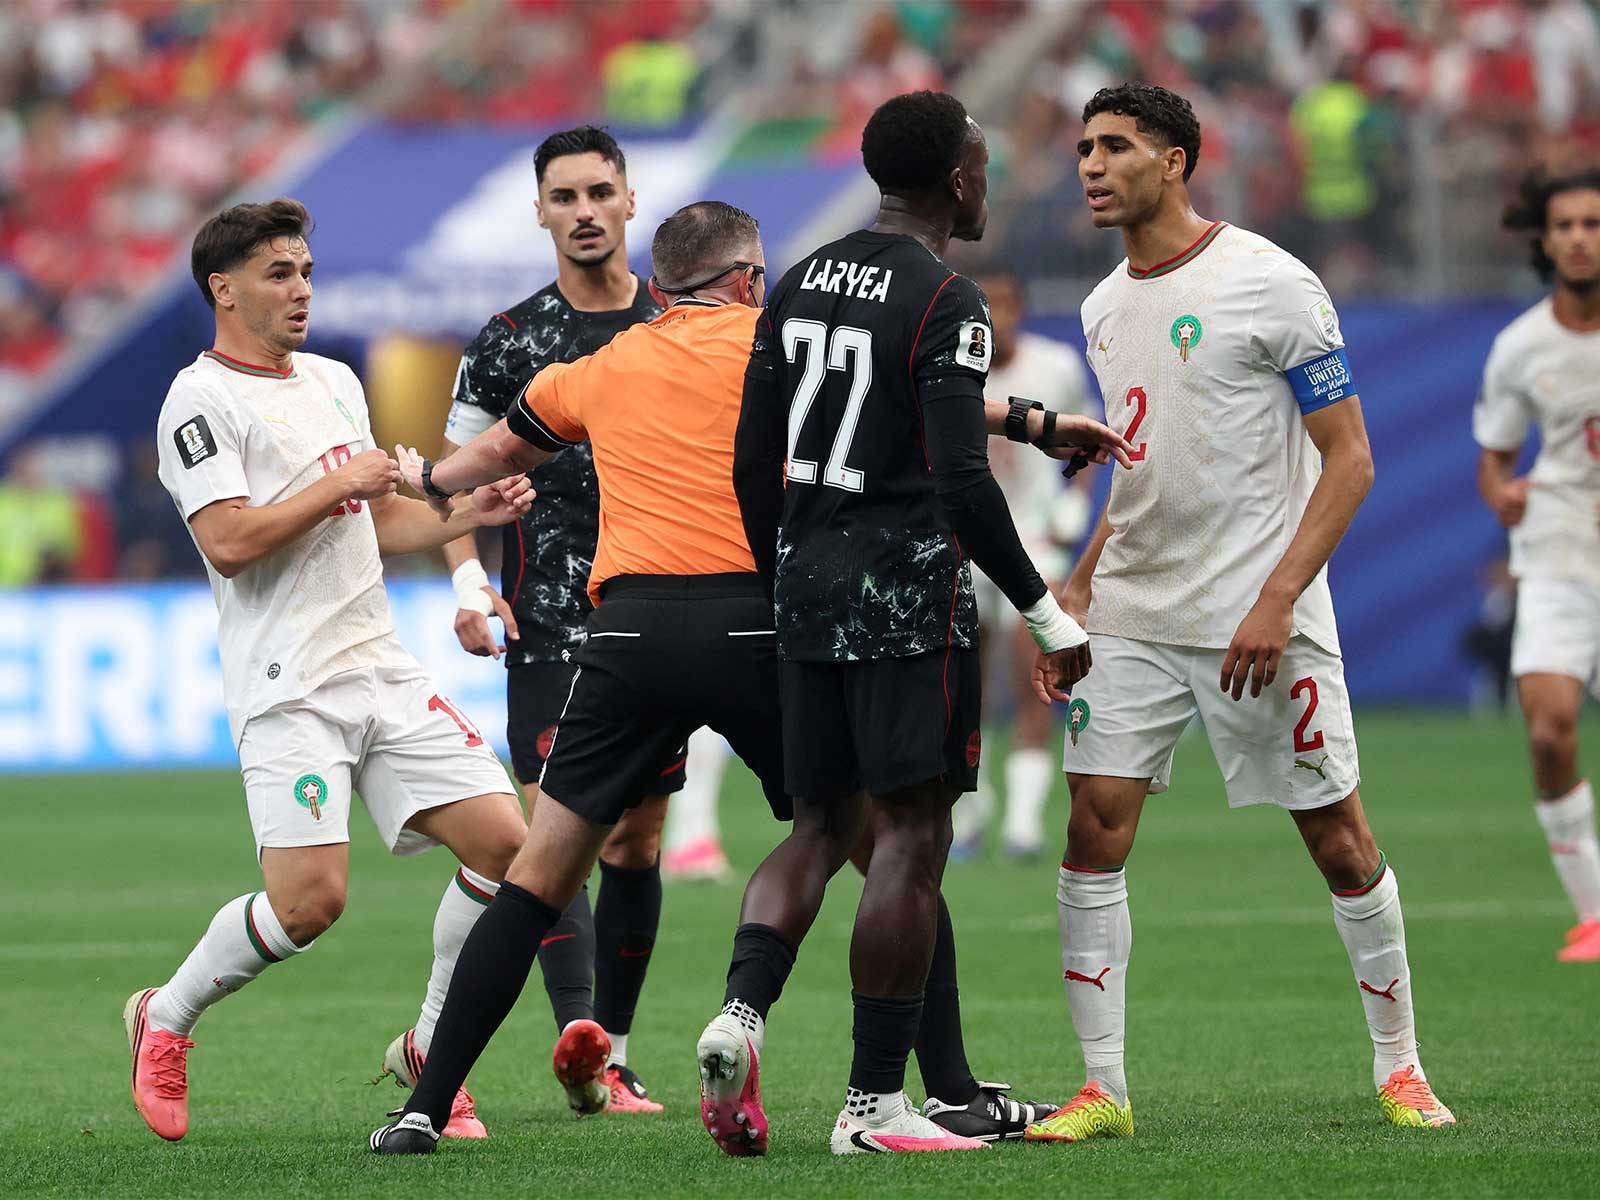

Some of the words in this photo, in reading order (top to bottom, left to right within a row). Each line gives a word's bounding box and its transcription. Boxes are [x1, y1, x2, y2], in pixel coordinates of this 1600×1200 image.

[800, 258, 893, 303] LARYEA
[1304, 354, 1341, 375] FOOTBALL
[1308, 363, 1346, 386] UNITES
[1312, 384, 1328, 397] the
[1327, 373, 1350, 391] World
[1328, 389, 1343, 400] FIFA
[782, 317, 873, 493] 22
[1123, 386, 1147, 461] 2
[428, 694, 484, 748] 1
[1290, 676, 1325, 753] 2
[403, 1119, 430, 1130] adidas
